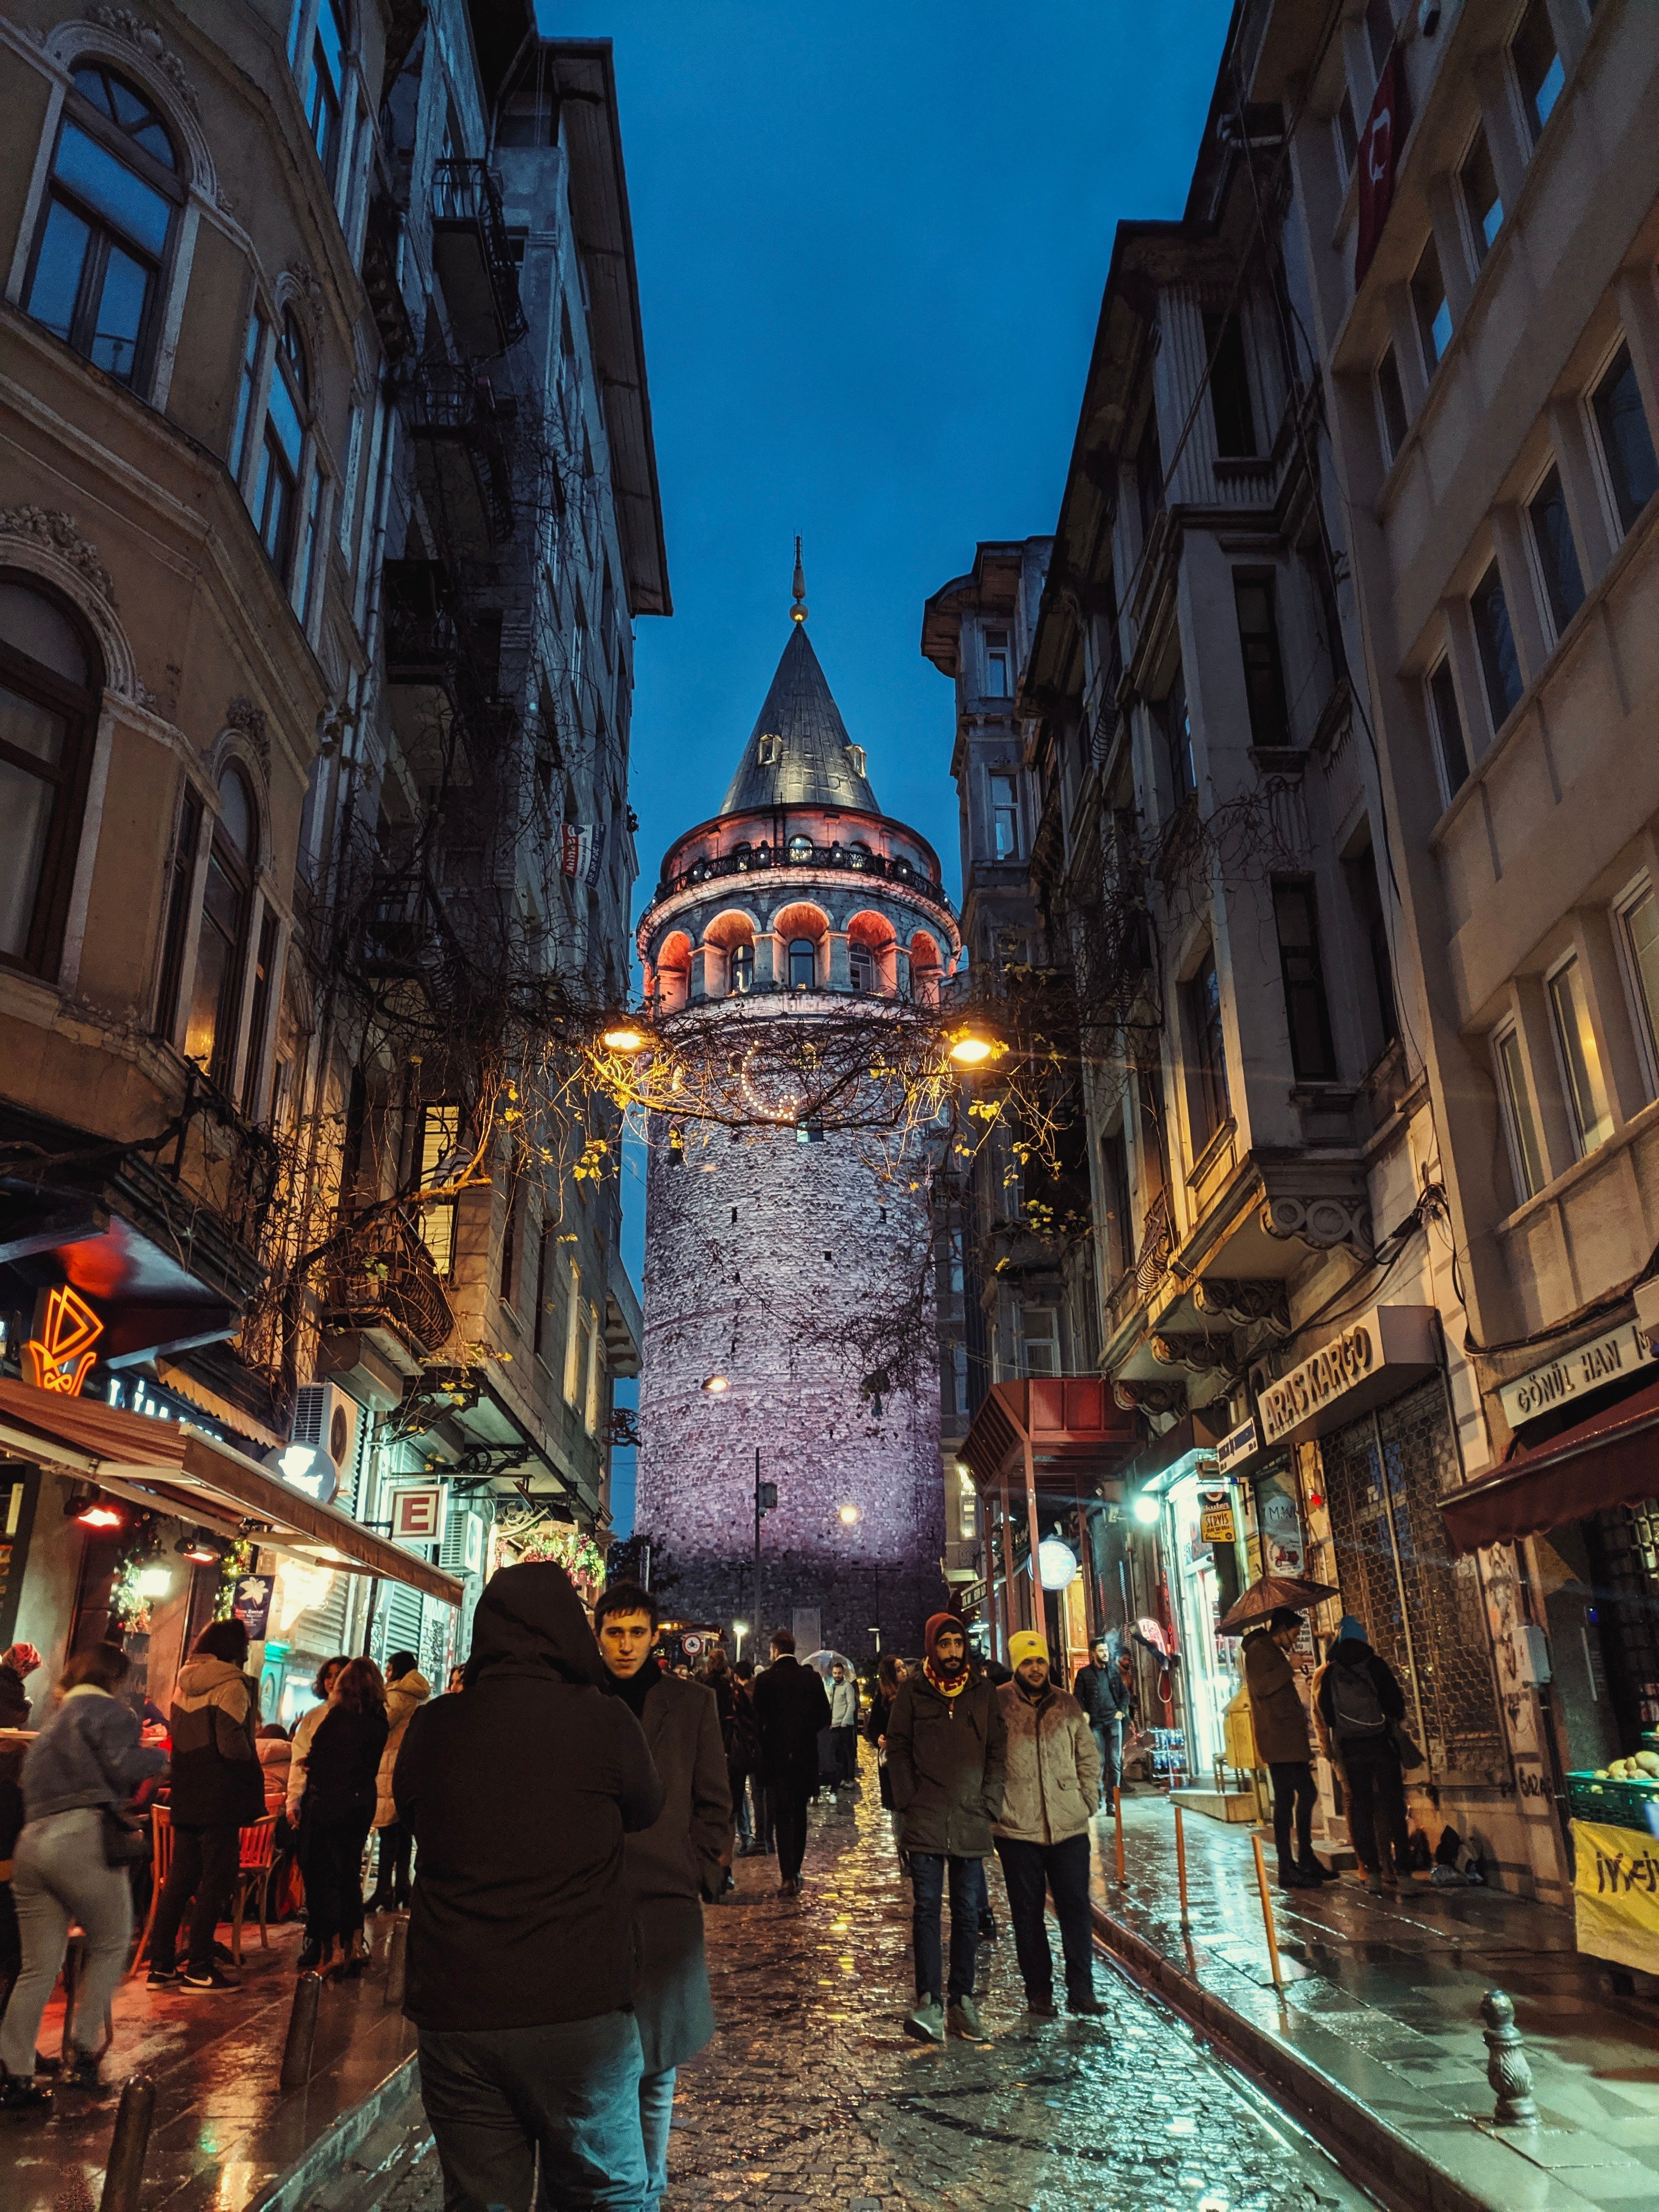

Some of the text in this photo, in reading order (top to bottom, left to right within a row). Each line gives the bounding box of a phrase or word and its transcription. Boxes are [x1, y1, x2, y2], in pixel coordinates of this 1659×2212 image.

[1264, 1326, 1372, 1434] ARAS KARGO
[1518, 1362, 1575, 1413] GÖNÜL
[1581, 1339, 1622, 1382] HAN
[400, 1497, 430, 1531] E
[1206, 1513, 1229, 1528] SERVİS
